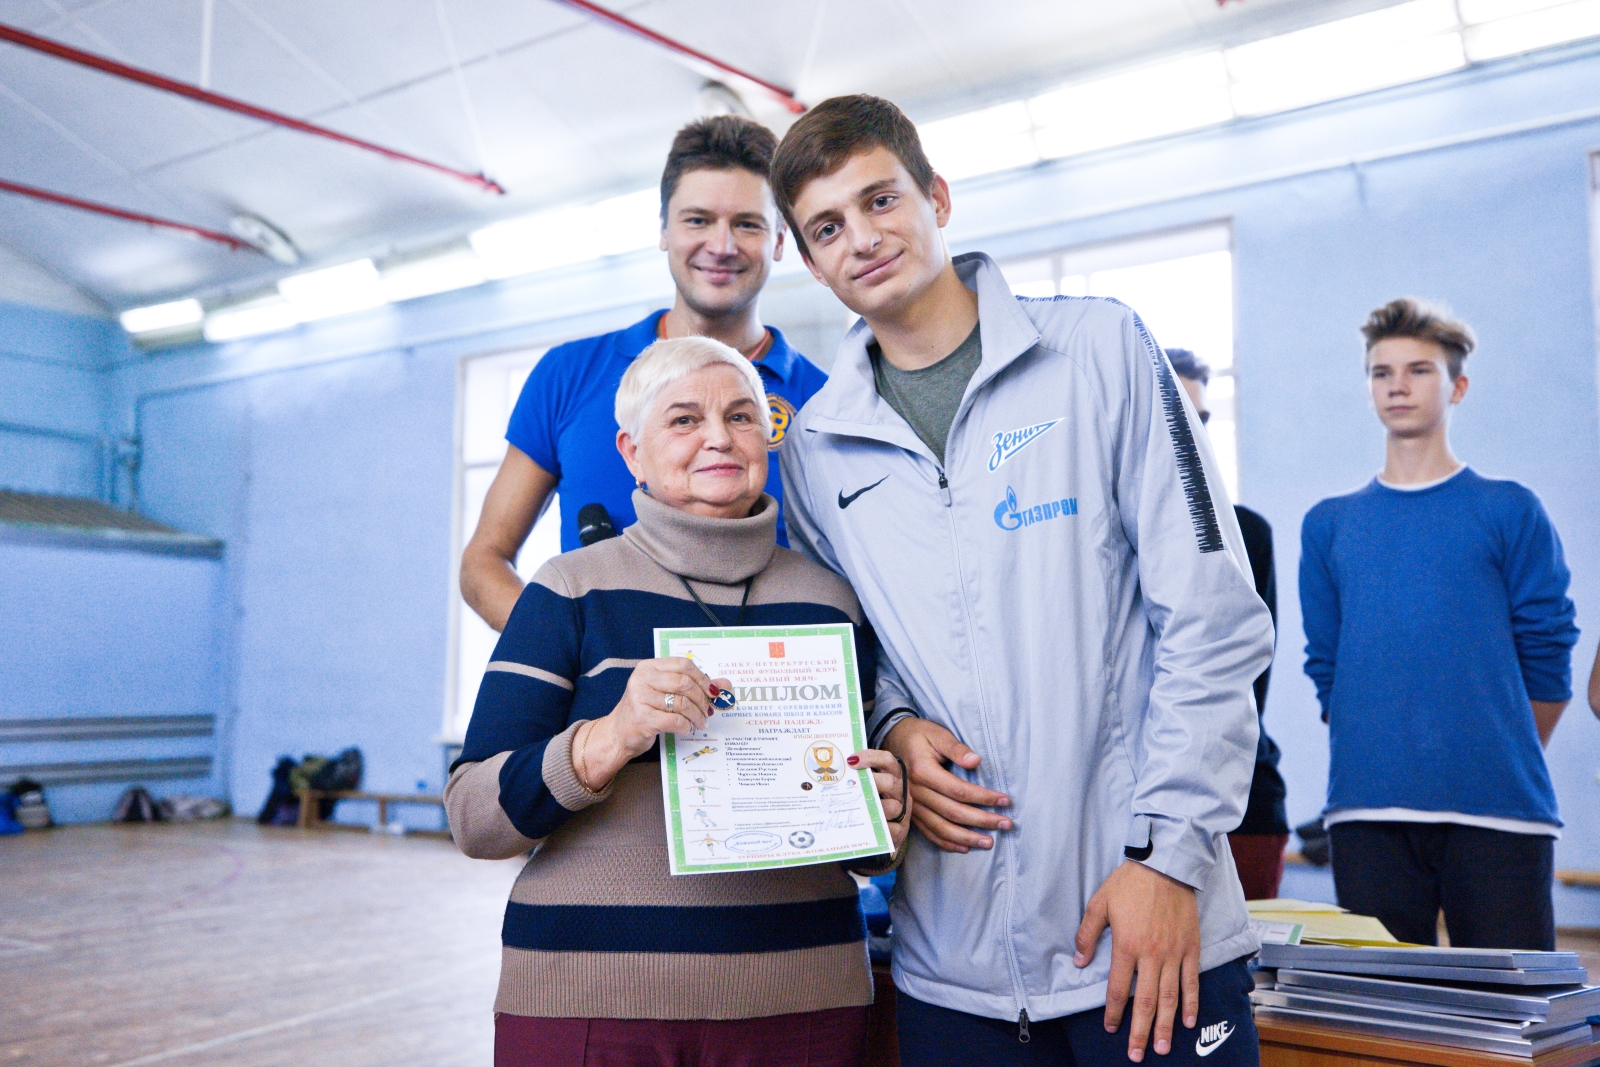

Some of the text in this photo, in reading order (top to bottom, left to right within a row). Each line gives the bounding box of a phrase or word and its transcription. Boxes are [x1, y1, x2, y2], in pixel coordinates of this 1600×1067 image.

[989, 420, 1057, 472] Зенит
[1022, 498, 1078, 527] ГАЗПРОМ
[718, 659, 837, 668] САНКТ-ПЕТЕРБУРГСКИЙ
[718, 668, 754, 676] ДЕТСКИЙ
[758, 667, 812, 675] ФУТБОЛЬНЫЙ
[1200, 1020, 1228, 1043] NIKE
